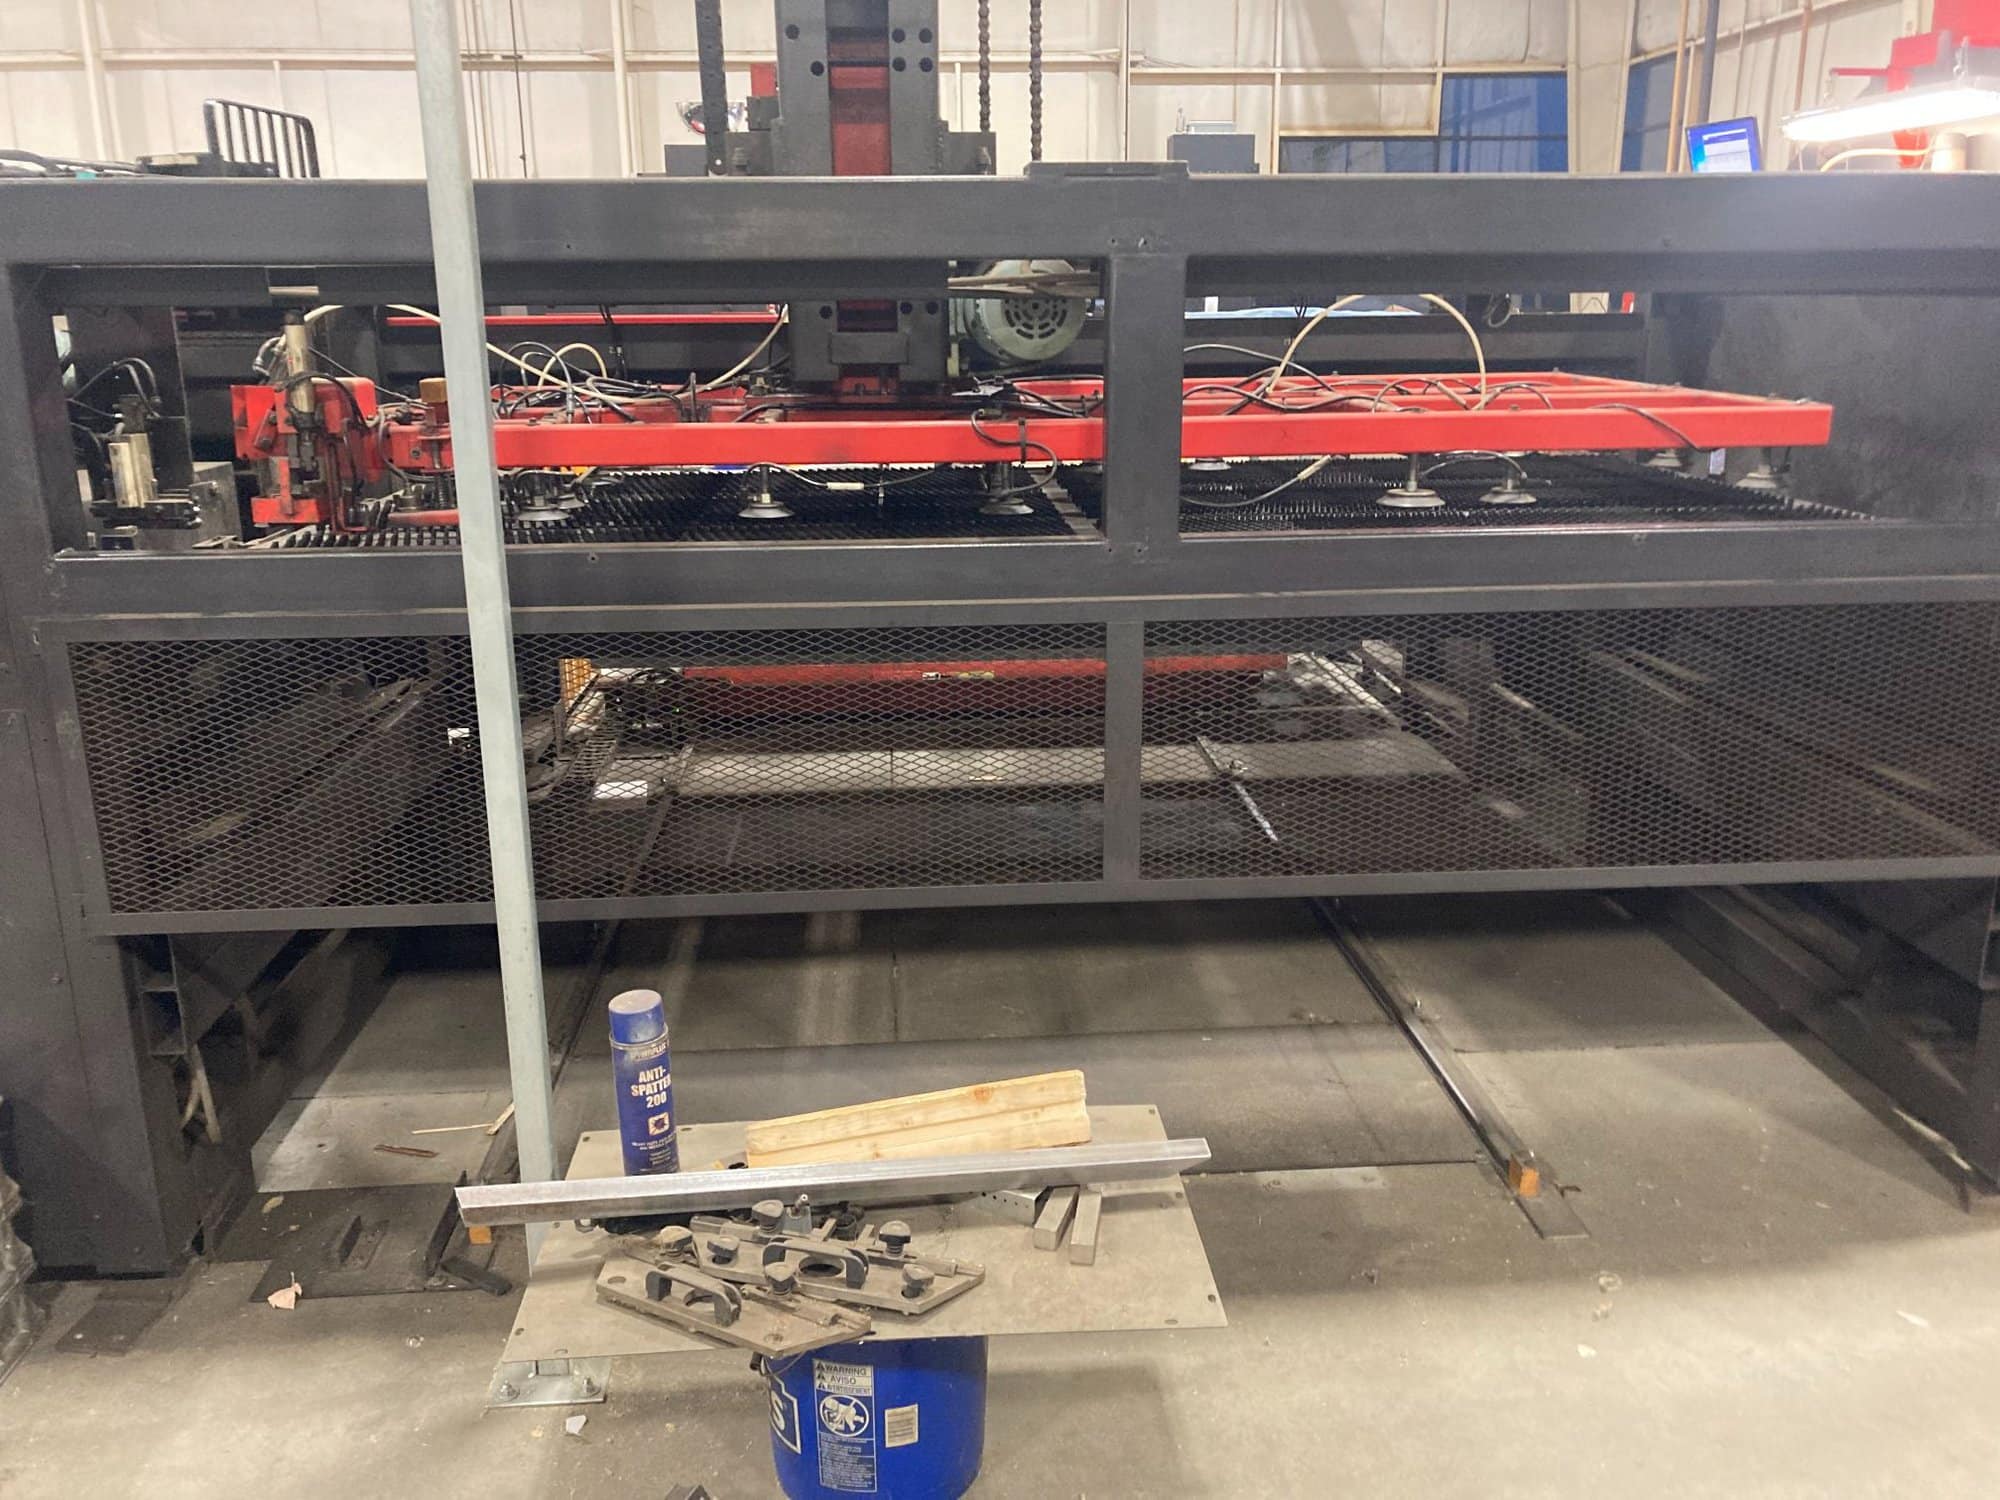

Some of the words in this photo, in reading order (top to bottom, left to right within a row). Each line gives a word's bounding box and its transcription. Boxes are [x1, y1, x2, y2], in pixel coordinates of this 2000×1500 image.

[639, 1066, 666, 1083] ANTI-
[646, 1091, 667, 1108] 200
[825, 1363, 867, 1376] WARNING
[830, 1375, 857, 1385] AVISO
